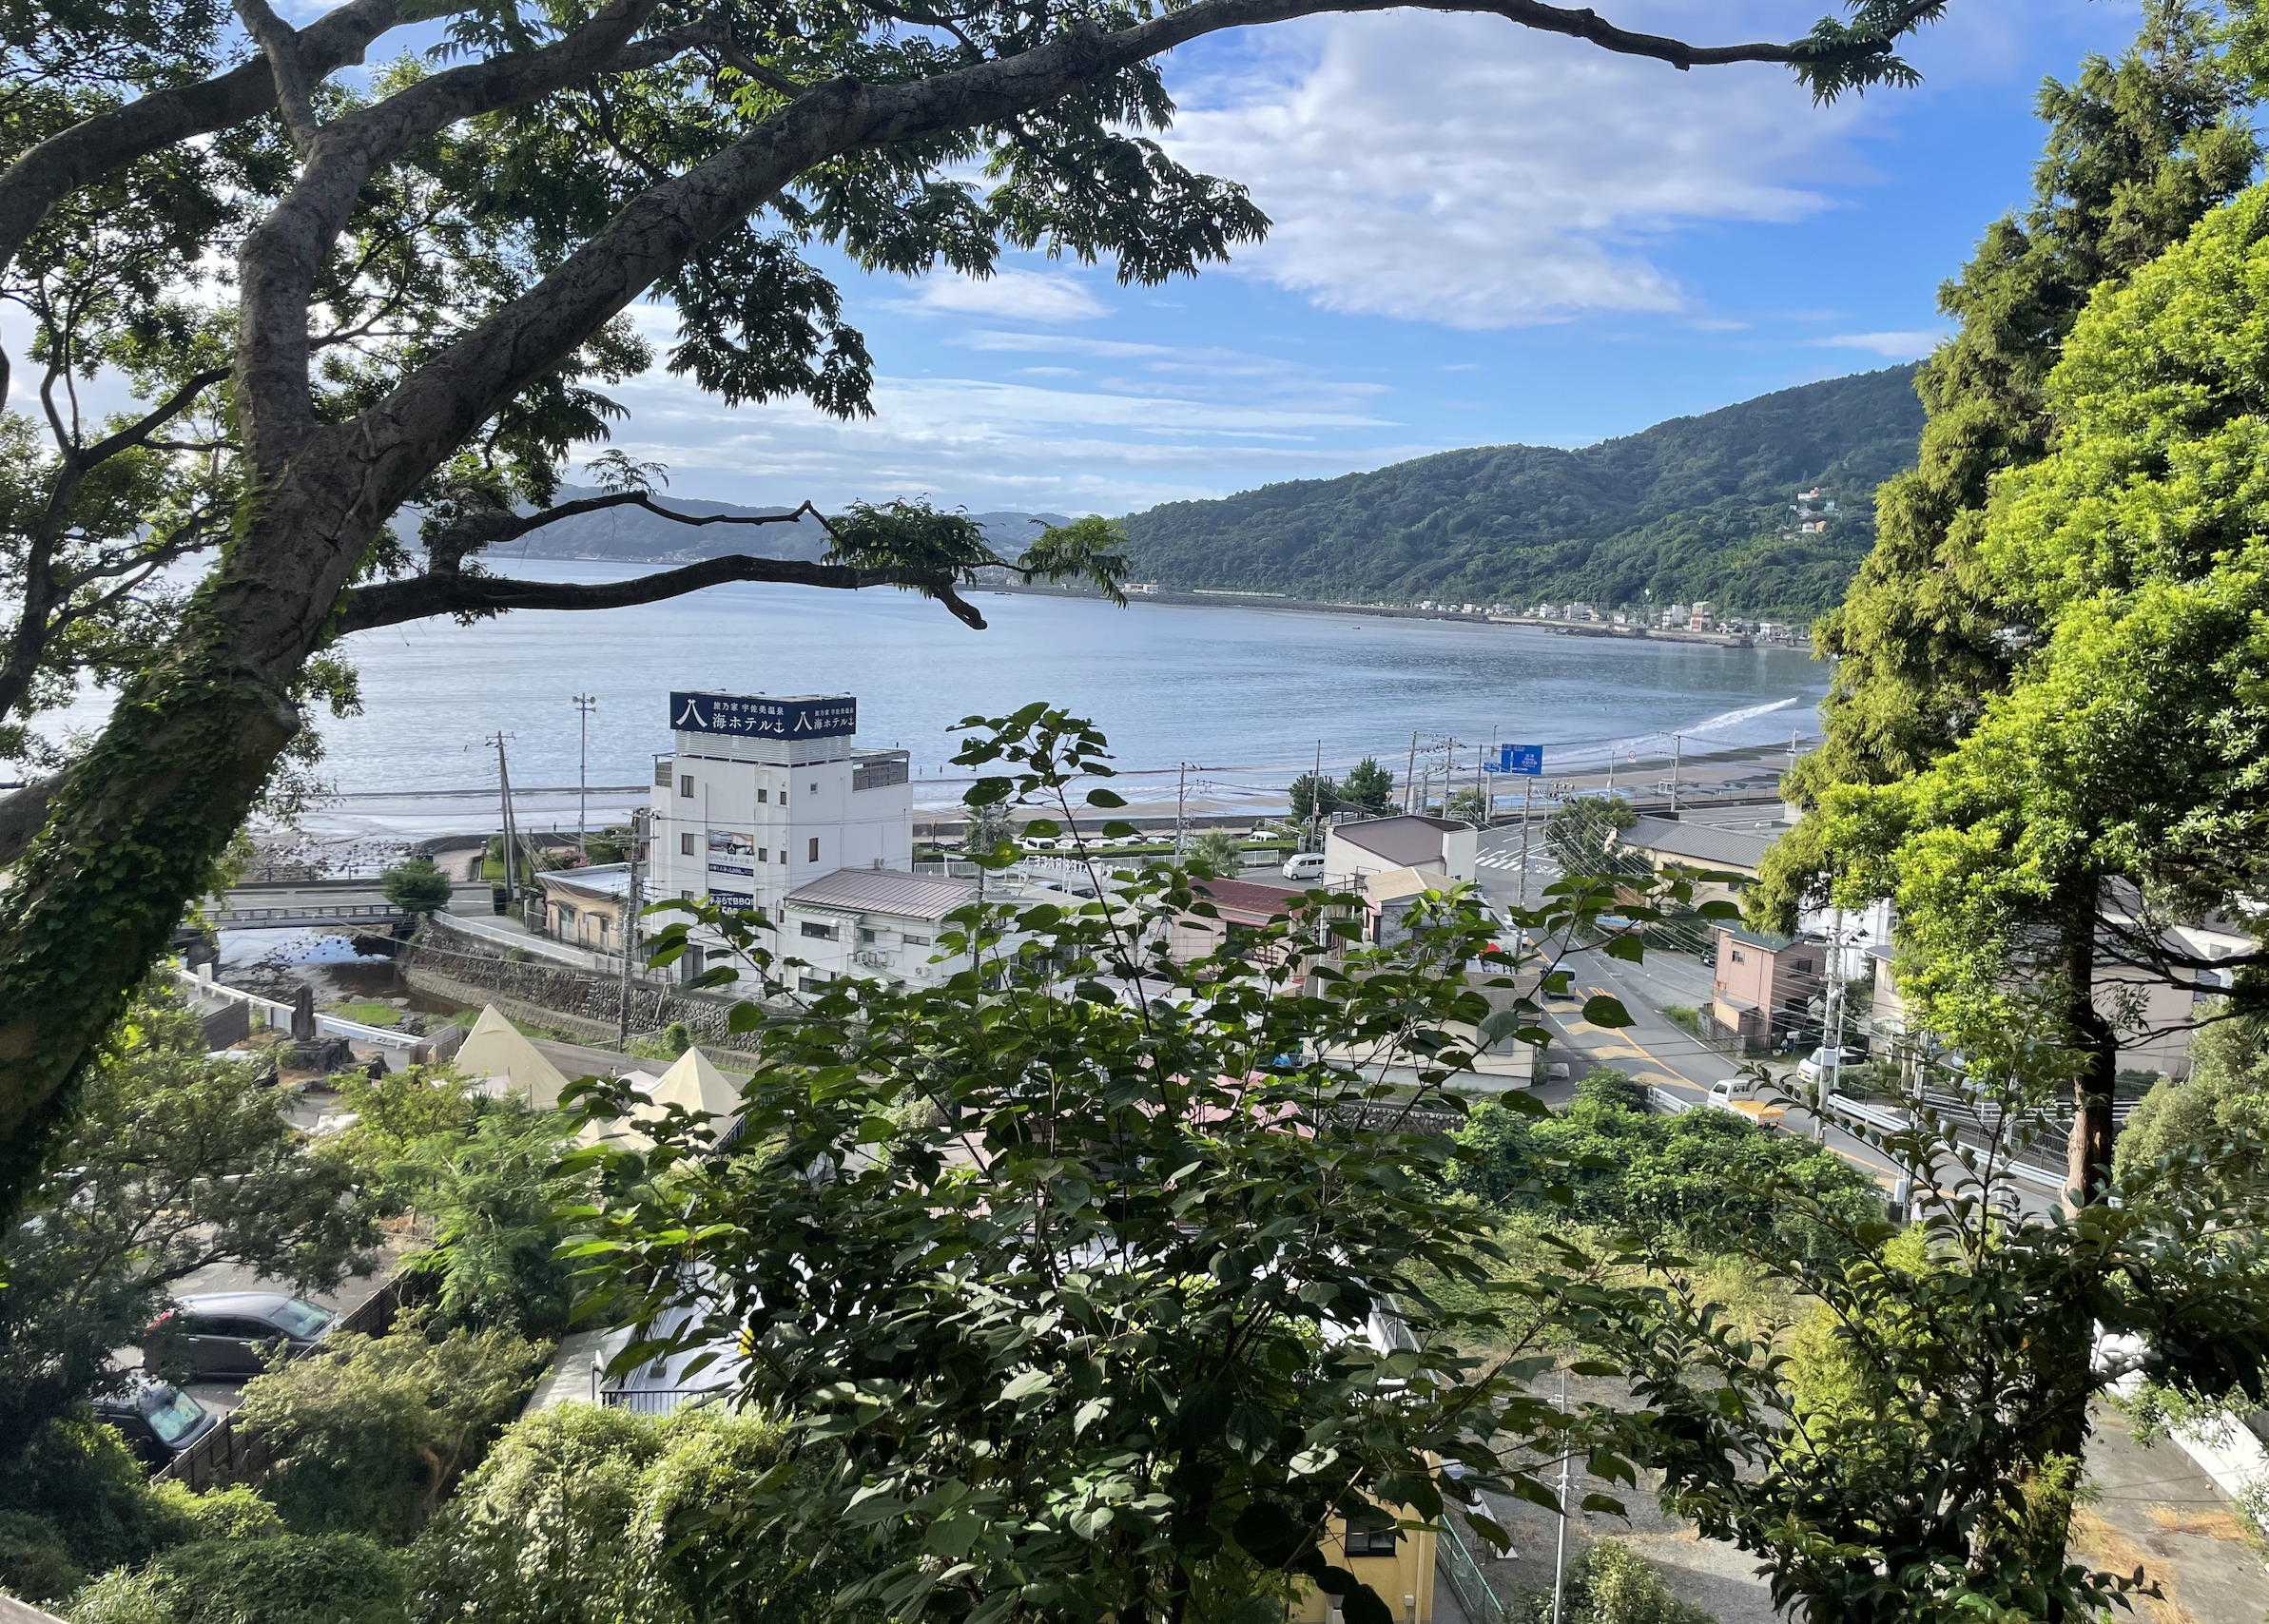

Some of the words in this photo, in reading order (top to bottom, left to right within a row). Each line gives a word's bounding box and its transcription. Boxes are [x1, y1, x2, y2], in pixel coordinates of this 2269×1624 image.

[712, 712, 773, 731] 海ホテル
[813, 717, 848, 730] 海ホテル
